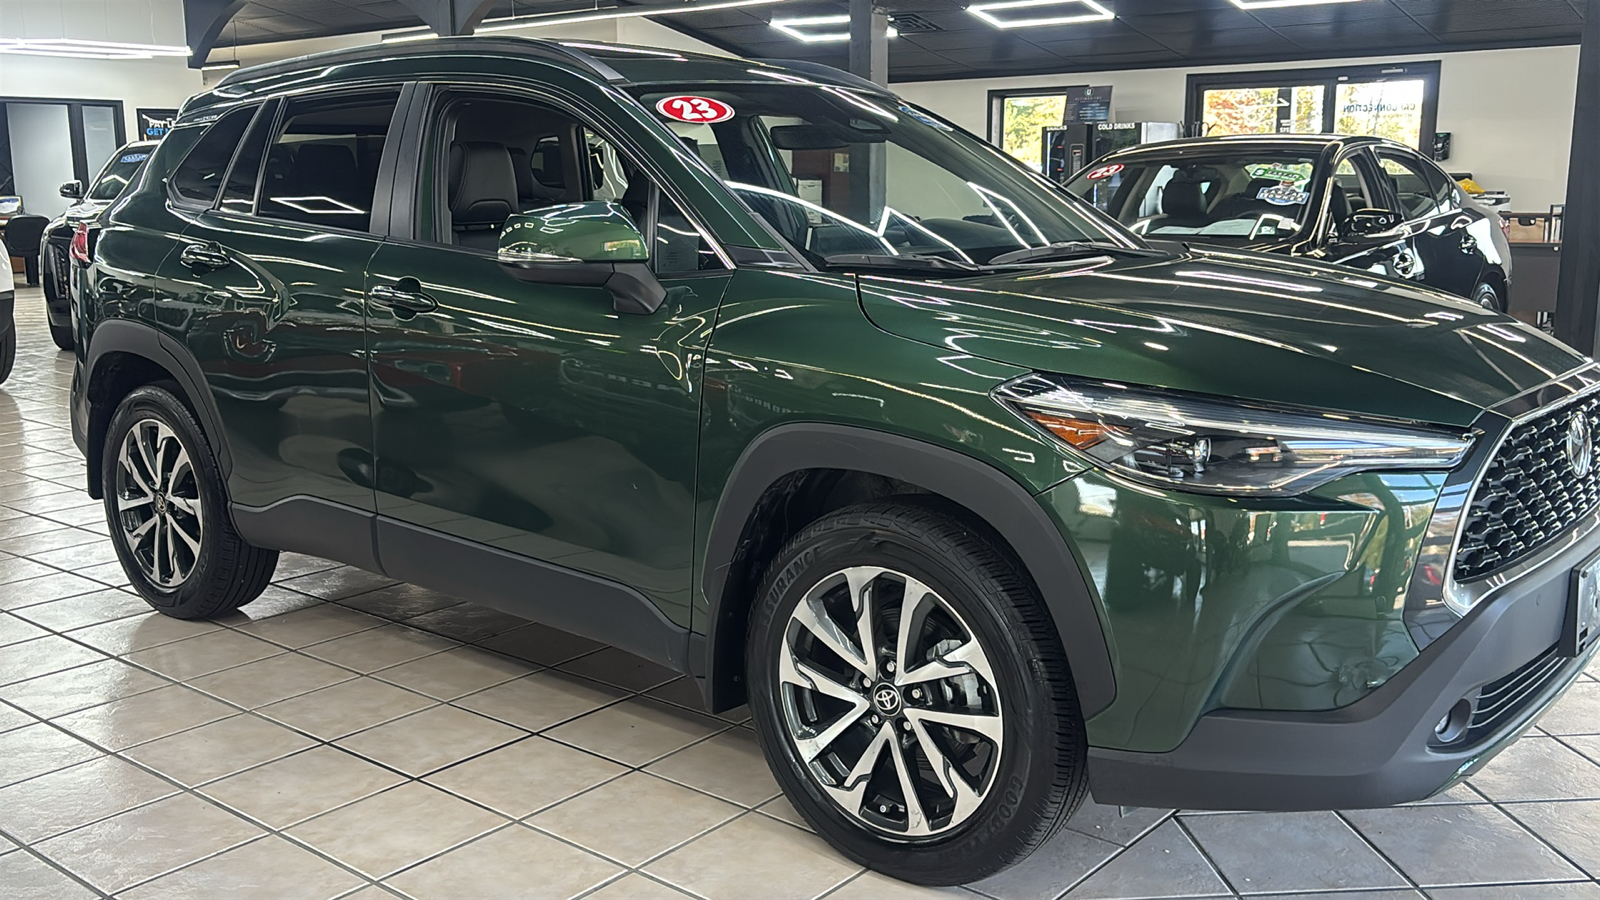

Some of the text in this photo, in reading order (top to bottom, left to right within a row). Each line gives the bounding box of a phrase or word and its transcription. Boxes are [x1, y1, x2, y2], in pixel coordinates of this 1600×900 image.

[672, 98, 718, 120] 23
[1097, 122, 1136, 131] COLD DRINKS
[146, 127, 164, 136] GET
